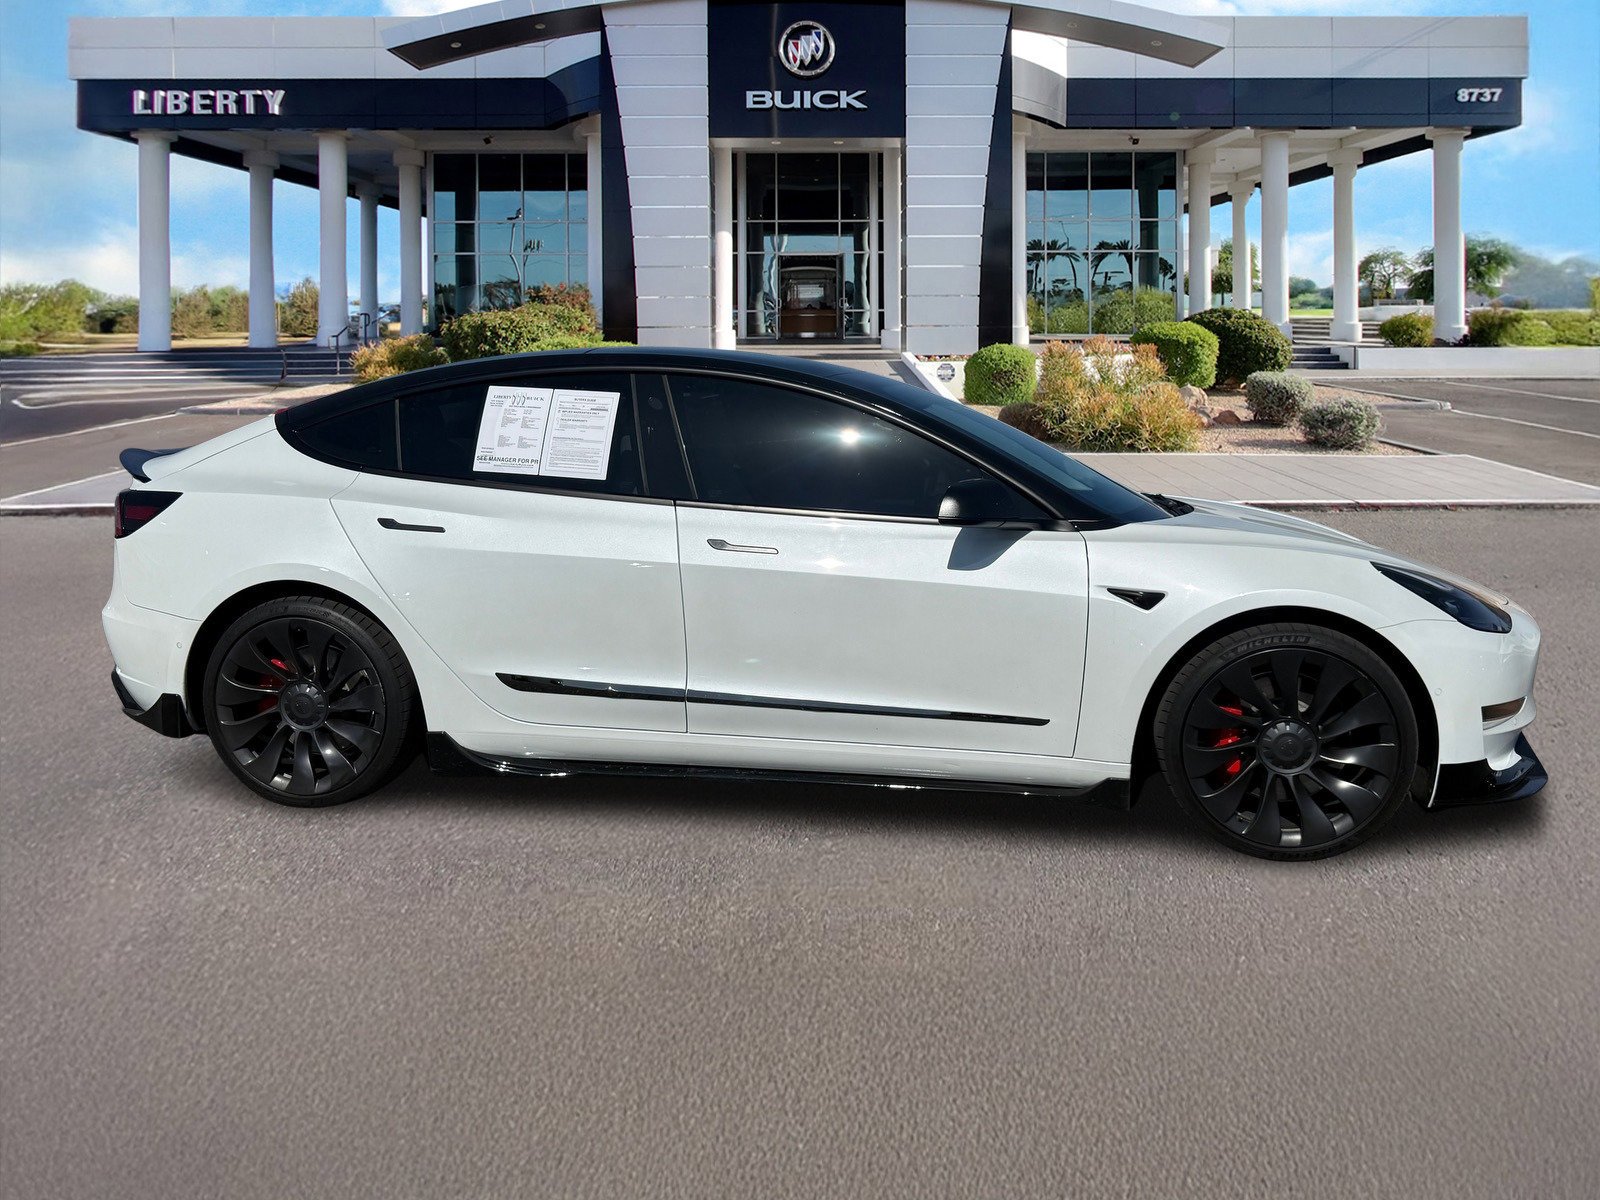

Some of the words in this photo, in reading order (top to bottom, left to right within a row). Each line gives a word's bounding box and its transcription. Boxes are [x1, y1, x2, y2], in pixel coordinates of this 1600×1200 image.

[132, 89, 285, 115] LIBERTY
[745, 89, 868, 109] BUICK
[1456, 87, 1503, 102] 8737
[1236, 635, 1308, 653] MICHELIN
